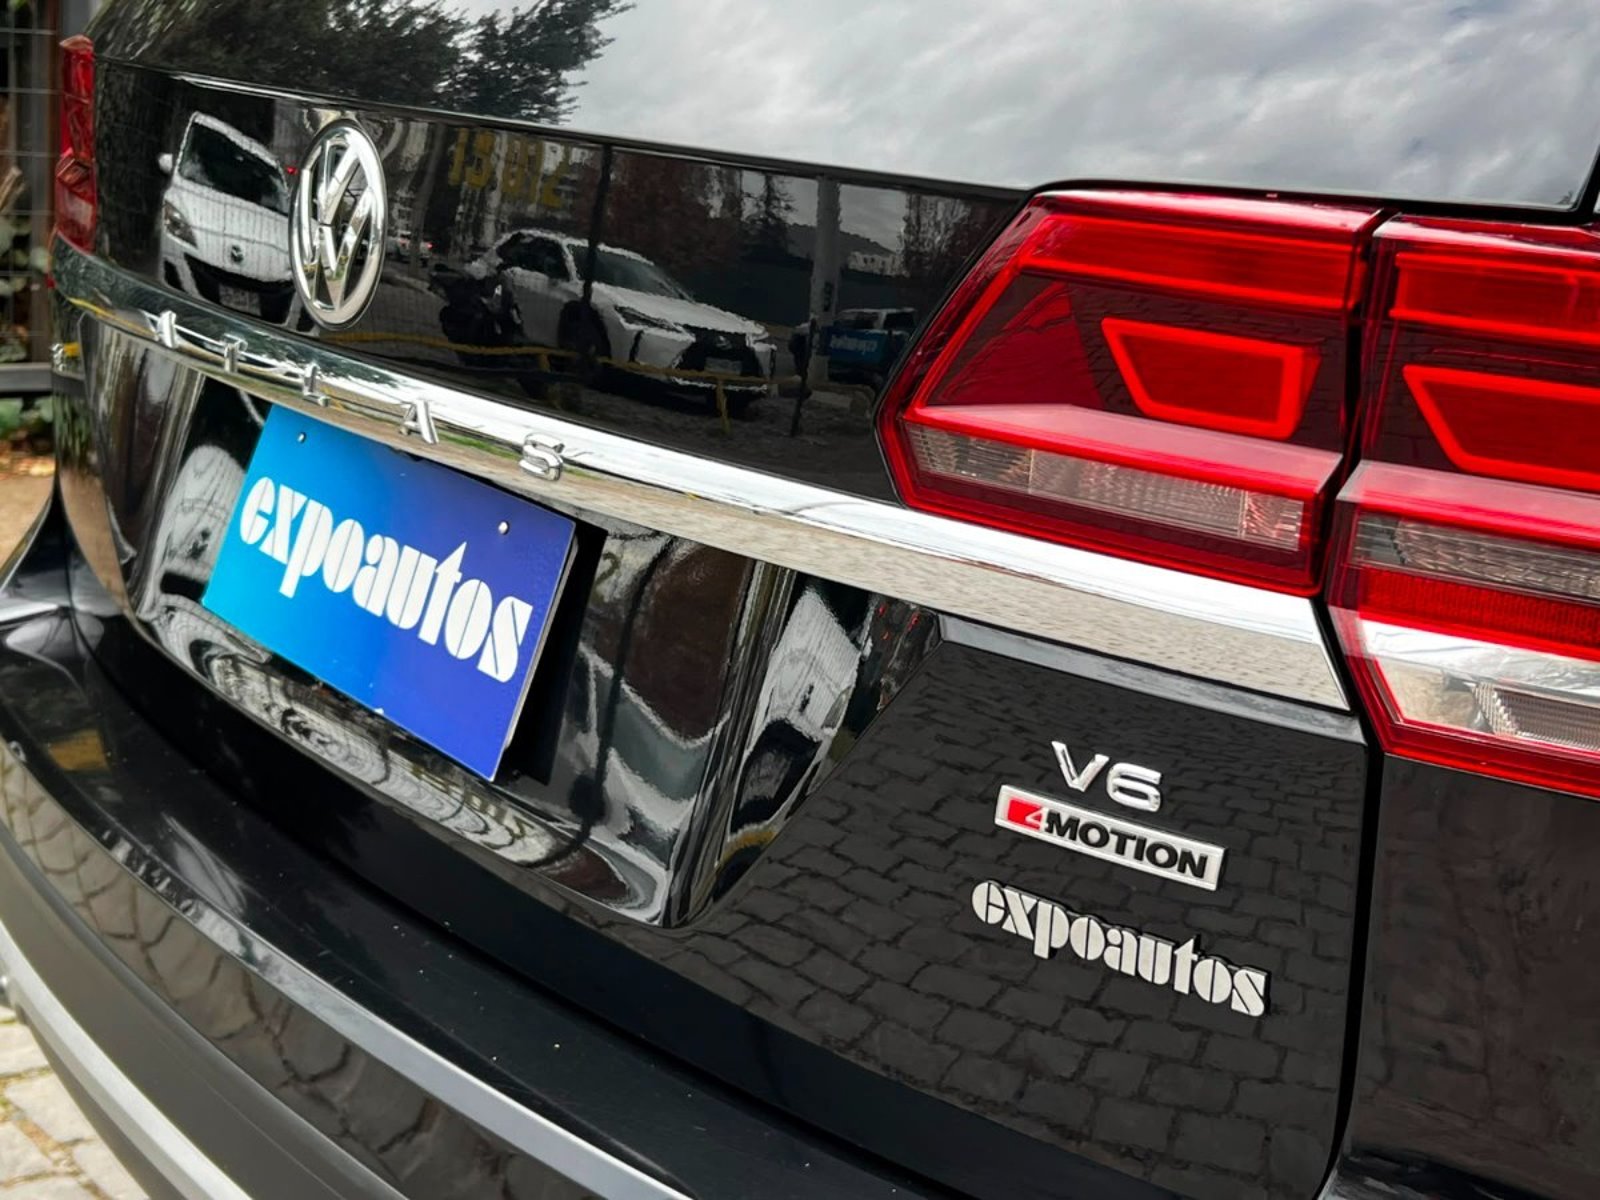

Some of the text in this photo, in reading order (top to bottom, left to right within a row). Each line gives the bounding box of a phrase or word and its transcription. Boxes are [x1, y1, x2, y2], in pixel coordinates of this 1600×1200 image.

[156, 310, 565, 482] ATLAS
[239, 476, 534, 683] expoautos
[1024, 805, 1209, 880] 4MOTION
[1051, 740, 1162, 812] V6
[971, 879, 1270, 1017] expoautos
